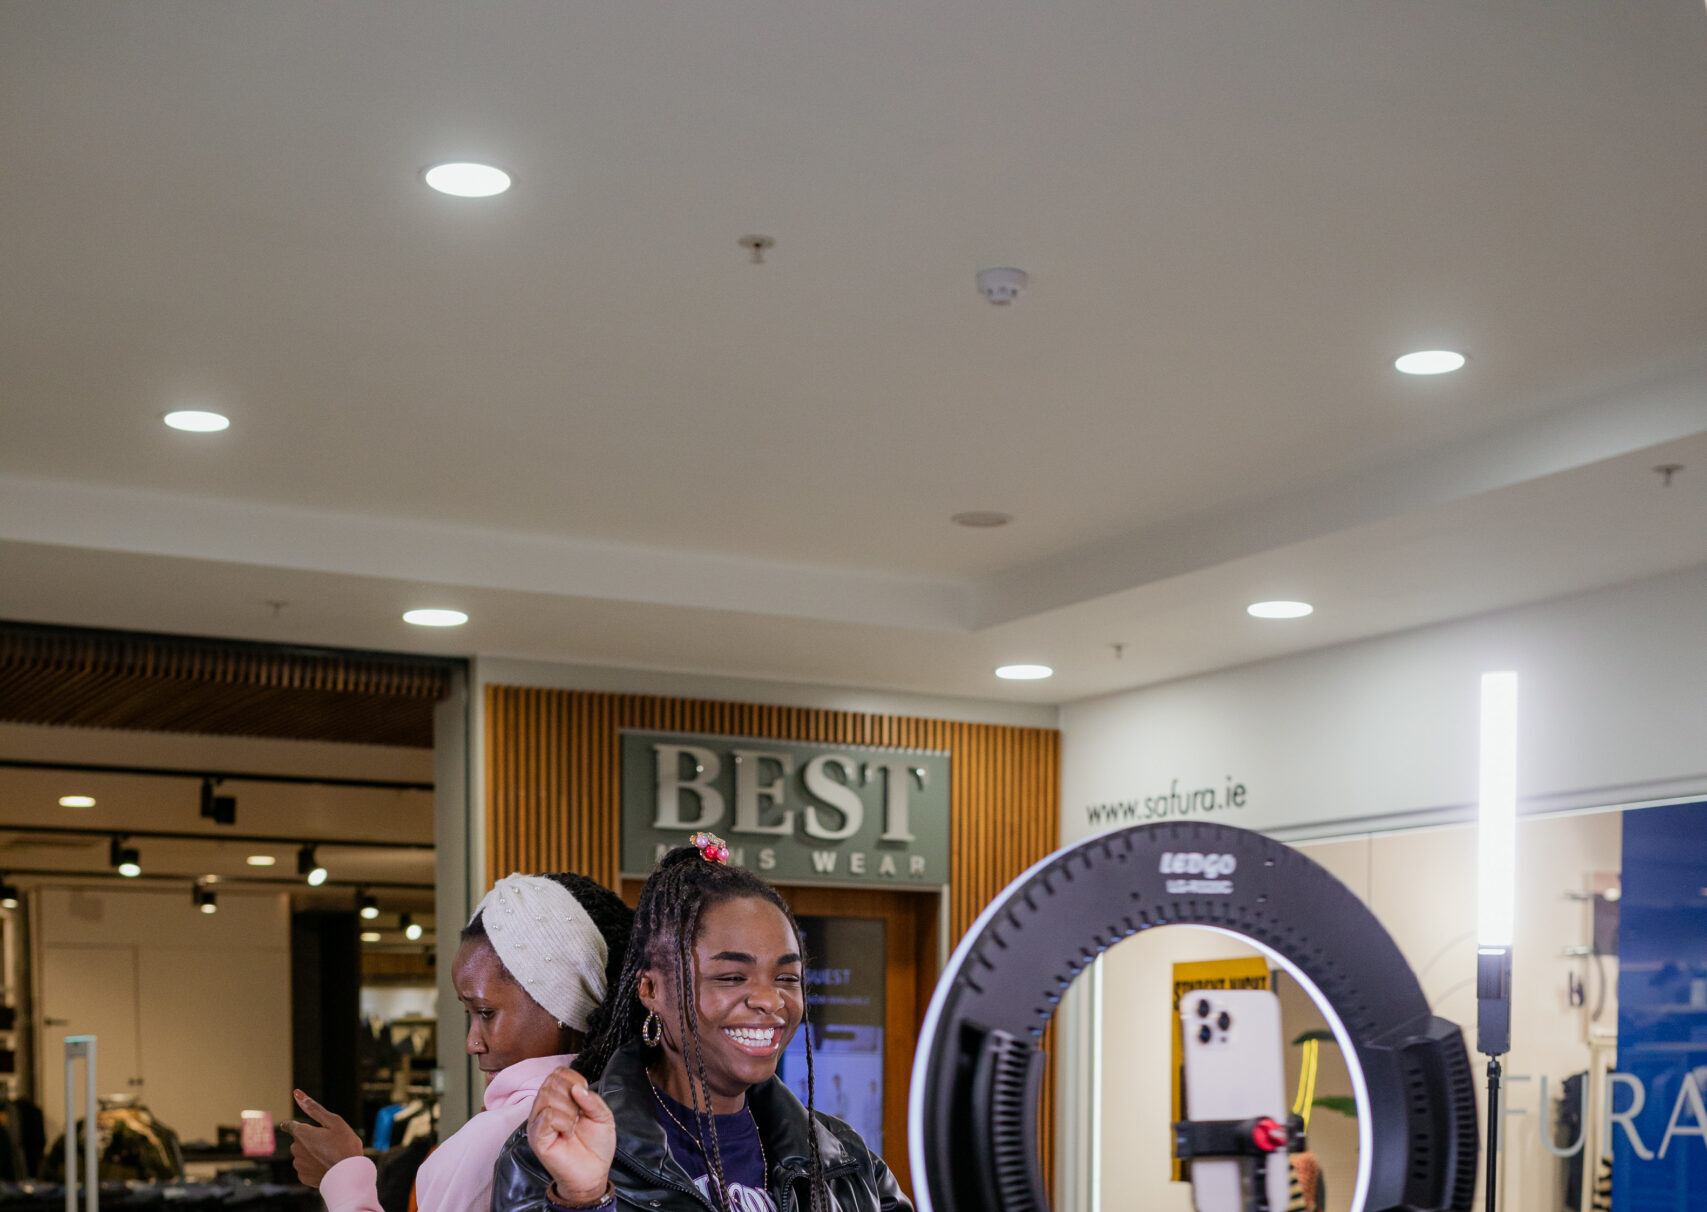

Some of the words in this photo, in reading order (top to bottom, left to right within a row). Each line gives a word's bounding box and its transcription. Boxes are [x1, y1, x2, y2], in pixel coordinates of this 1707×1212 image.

[653, 743, 930, 843] BEST
[1087, 775, 1246, 826] www.safura.ie
[812, 850, 926, 876] WEAR
